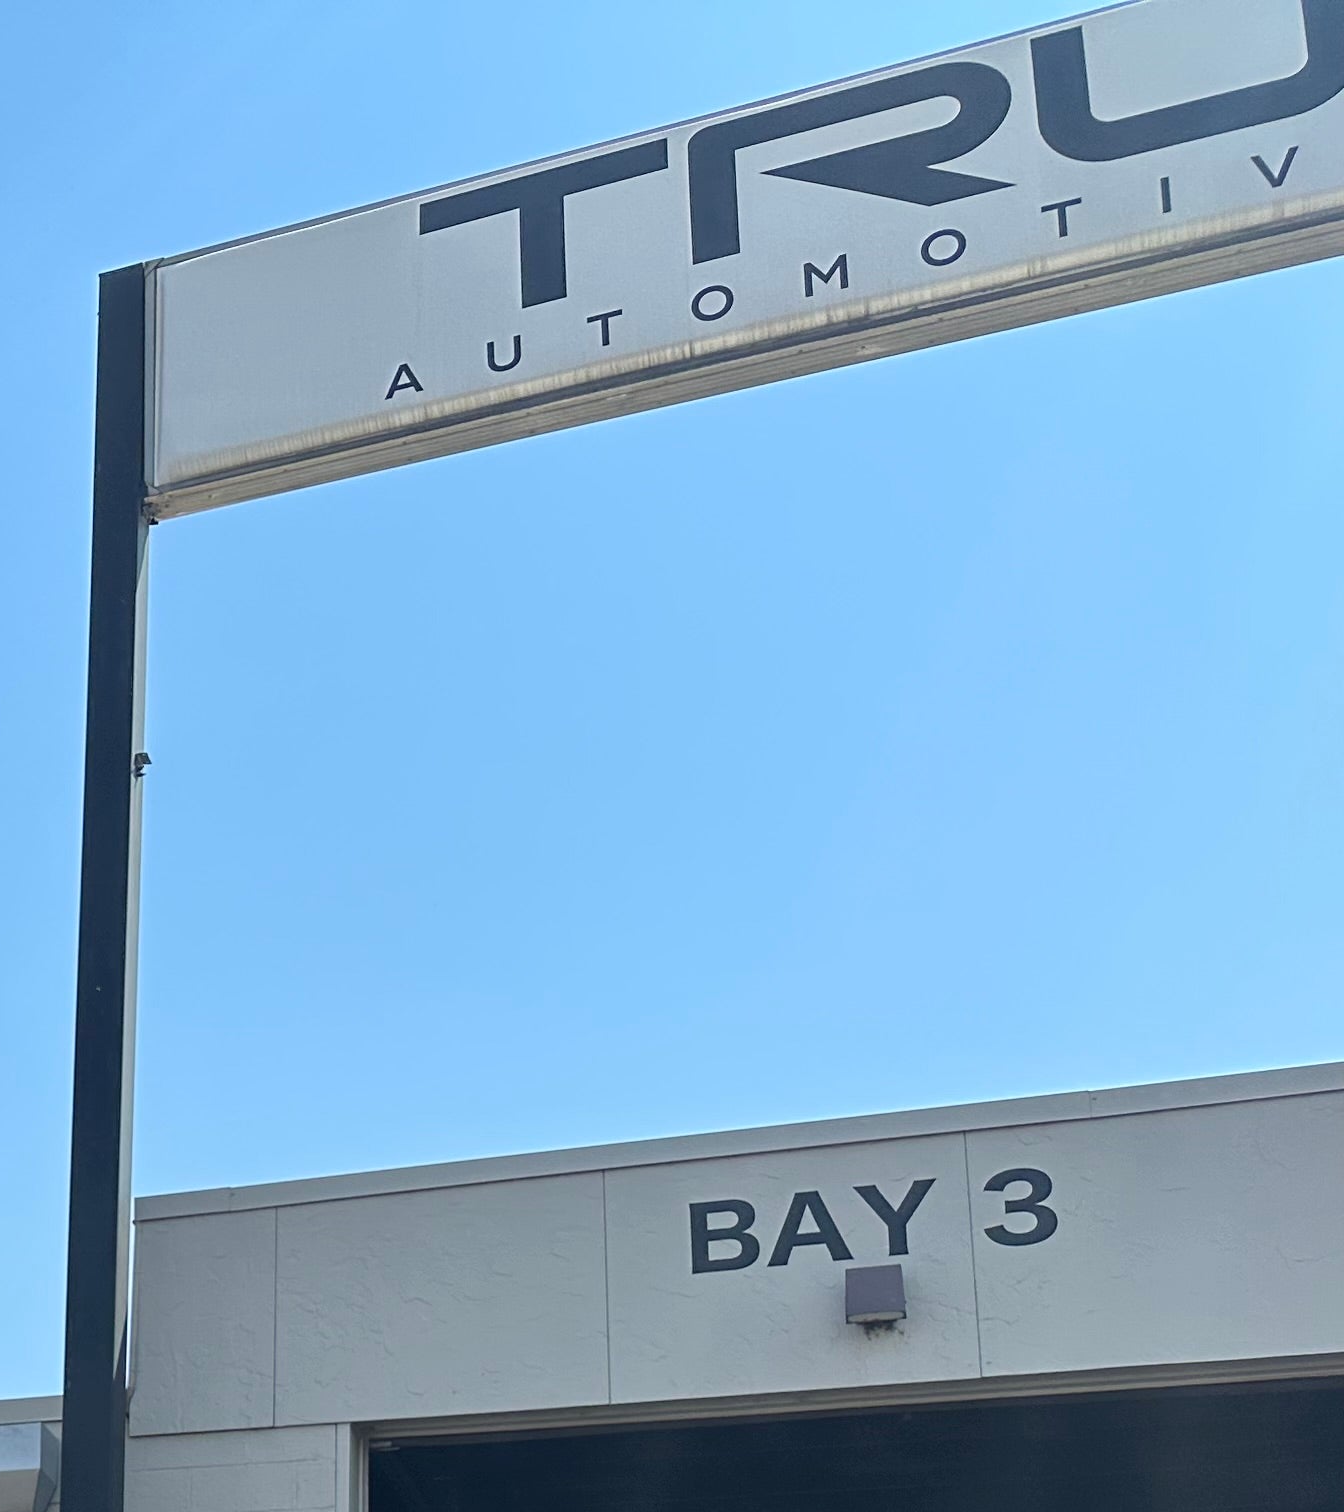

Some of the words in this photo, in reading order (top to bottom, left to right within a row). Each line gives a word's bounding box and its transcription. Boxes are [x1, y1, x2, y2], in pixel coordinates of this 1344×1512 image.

[384, 145, 1300, 400] AUTOMOTIV
[419, 0, 1344, 308] TRU
[689, 1178, 937, 1274] BAY
[982, 1168, 1058, 1247] 3
